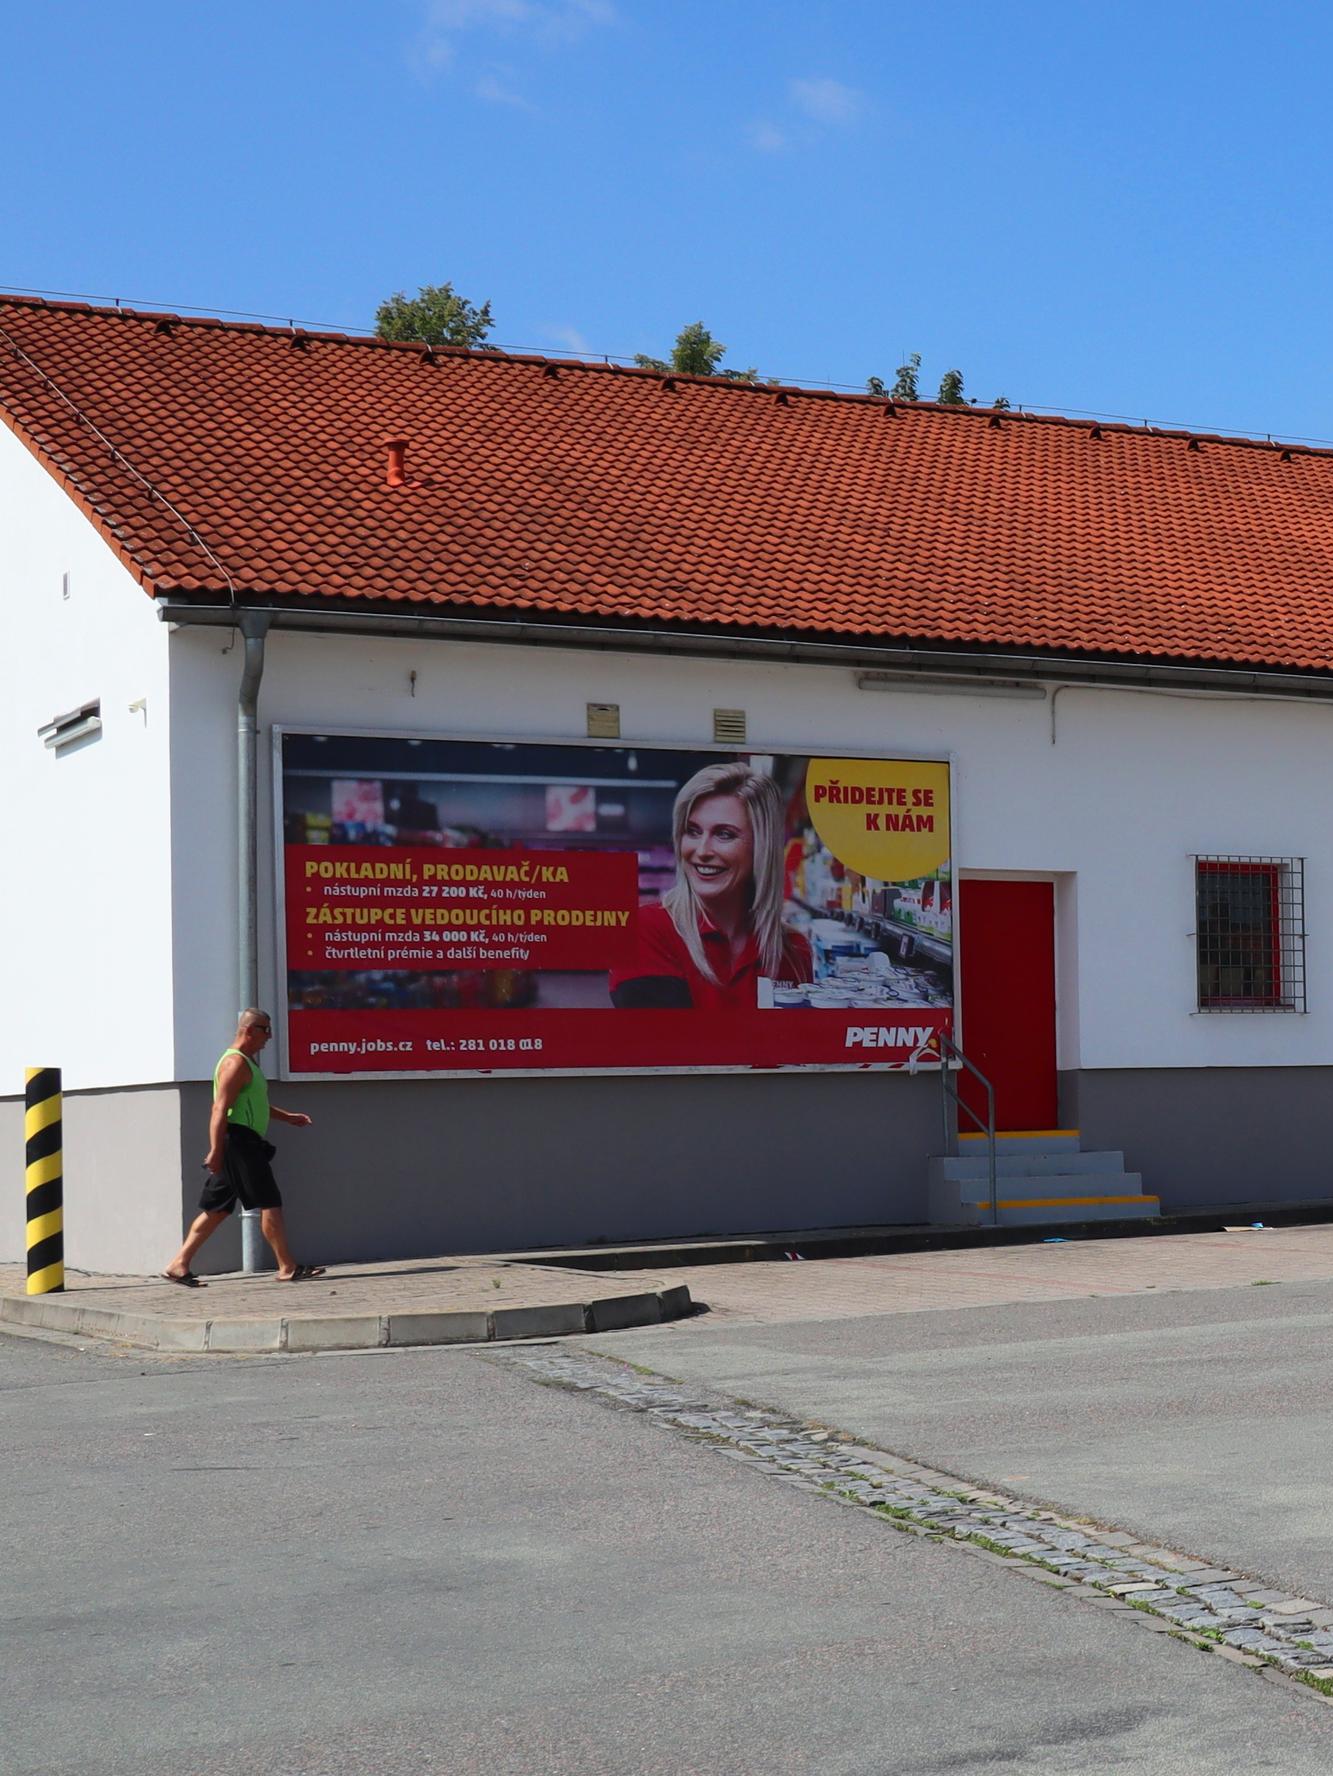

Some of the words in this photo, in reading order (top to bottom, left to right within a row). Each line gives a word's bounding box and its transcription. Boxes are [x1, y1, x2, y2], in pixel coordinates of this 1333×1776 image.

[814, 780, 907, 807] PŘIDEJTE
[912, 789, 934, 807] SE
[865, 813, 880, 831] K
[885, 808, 934, 832] NÁM
[305, 859, 418, 882] POKLADNÍ,
[423, 861, 569, 883] PRODAVAČ/KA
[323, 884, 381, 899] nástupní
[383, 886, 419, 898] mzda
[422, 886, 437, 898] 27
[441, 886, 467, 898] 200
[469, 885, 488, 899] Kč,
[490, 889, 503, 898] 40
[505, 888, 546, 900] h/týden
[305, 903, 406, 925] ZÁSTUPCE
[410, 904, 525, 926] VEDOUCÍHO
[530, 909, 631, 926] PRODEJNY
[325, 929, 382, 944] nástupní
[384, 931, 421, 942] mzda
[423, 931, 440, 942] 34
[442, 931, 468, 943] 000
[470, 930, 489, 944] Kč,
[491, 933, 506, 943] 40
[508, 932, 547, 944] h/týden
[325, 946, 384, 959] čtvrtletní
[387, 947, 433, 962] prémie
[436, 950, 444, 959] a
[446, 946, 476, 959] další
[479, 947, 530, 961] benefity
[310, 1039, 413, 1055] penny.jobs.cz
[426, 1039, 455, 1051] tel.:
[459, 1038, 485, 1051] 281
[489, 1038, 515, 1051] 018
